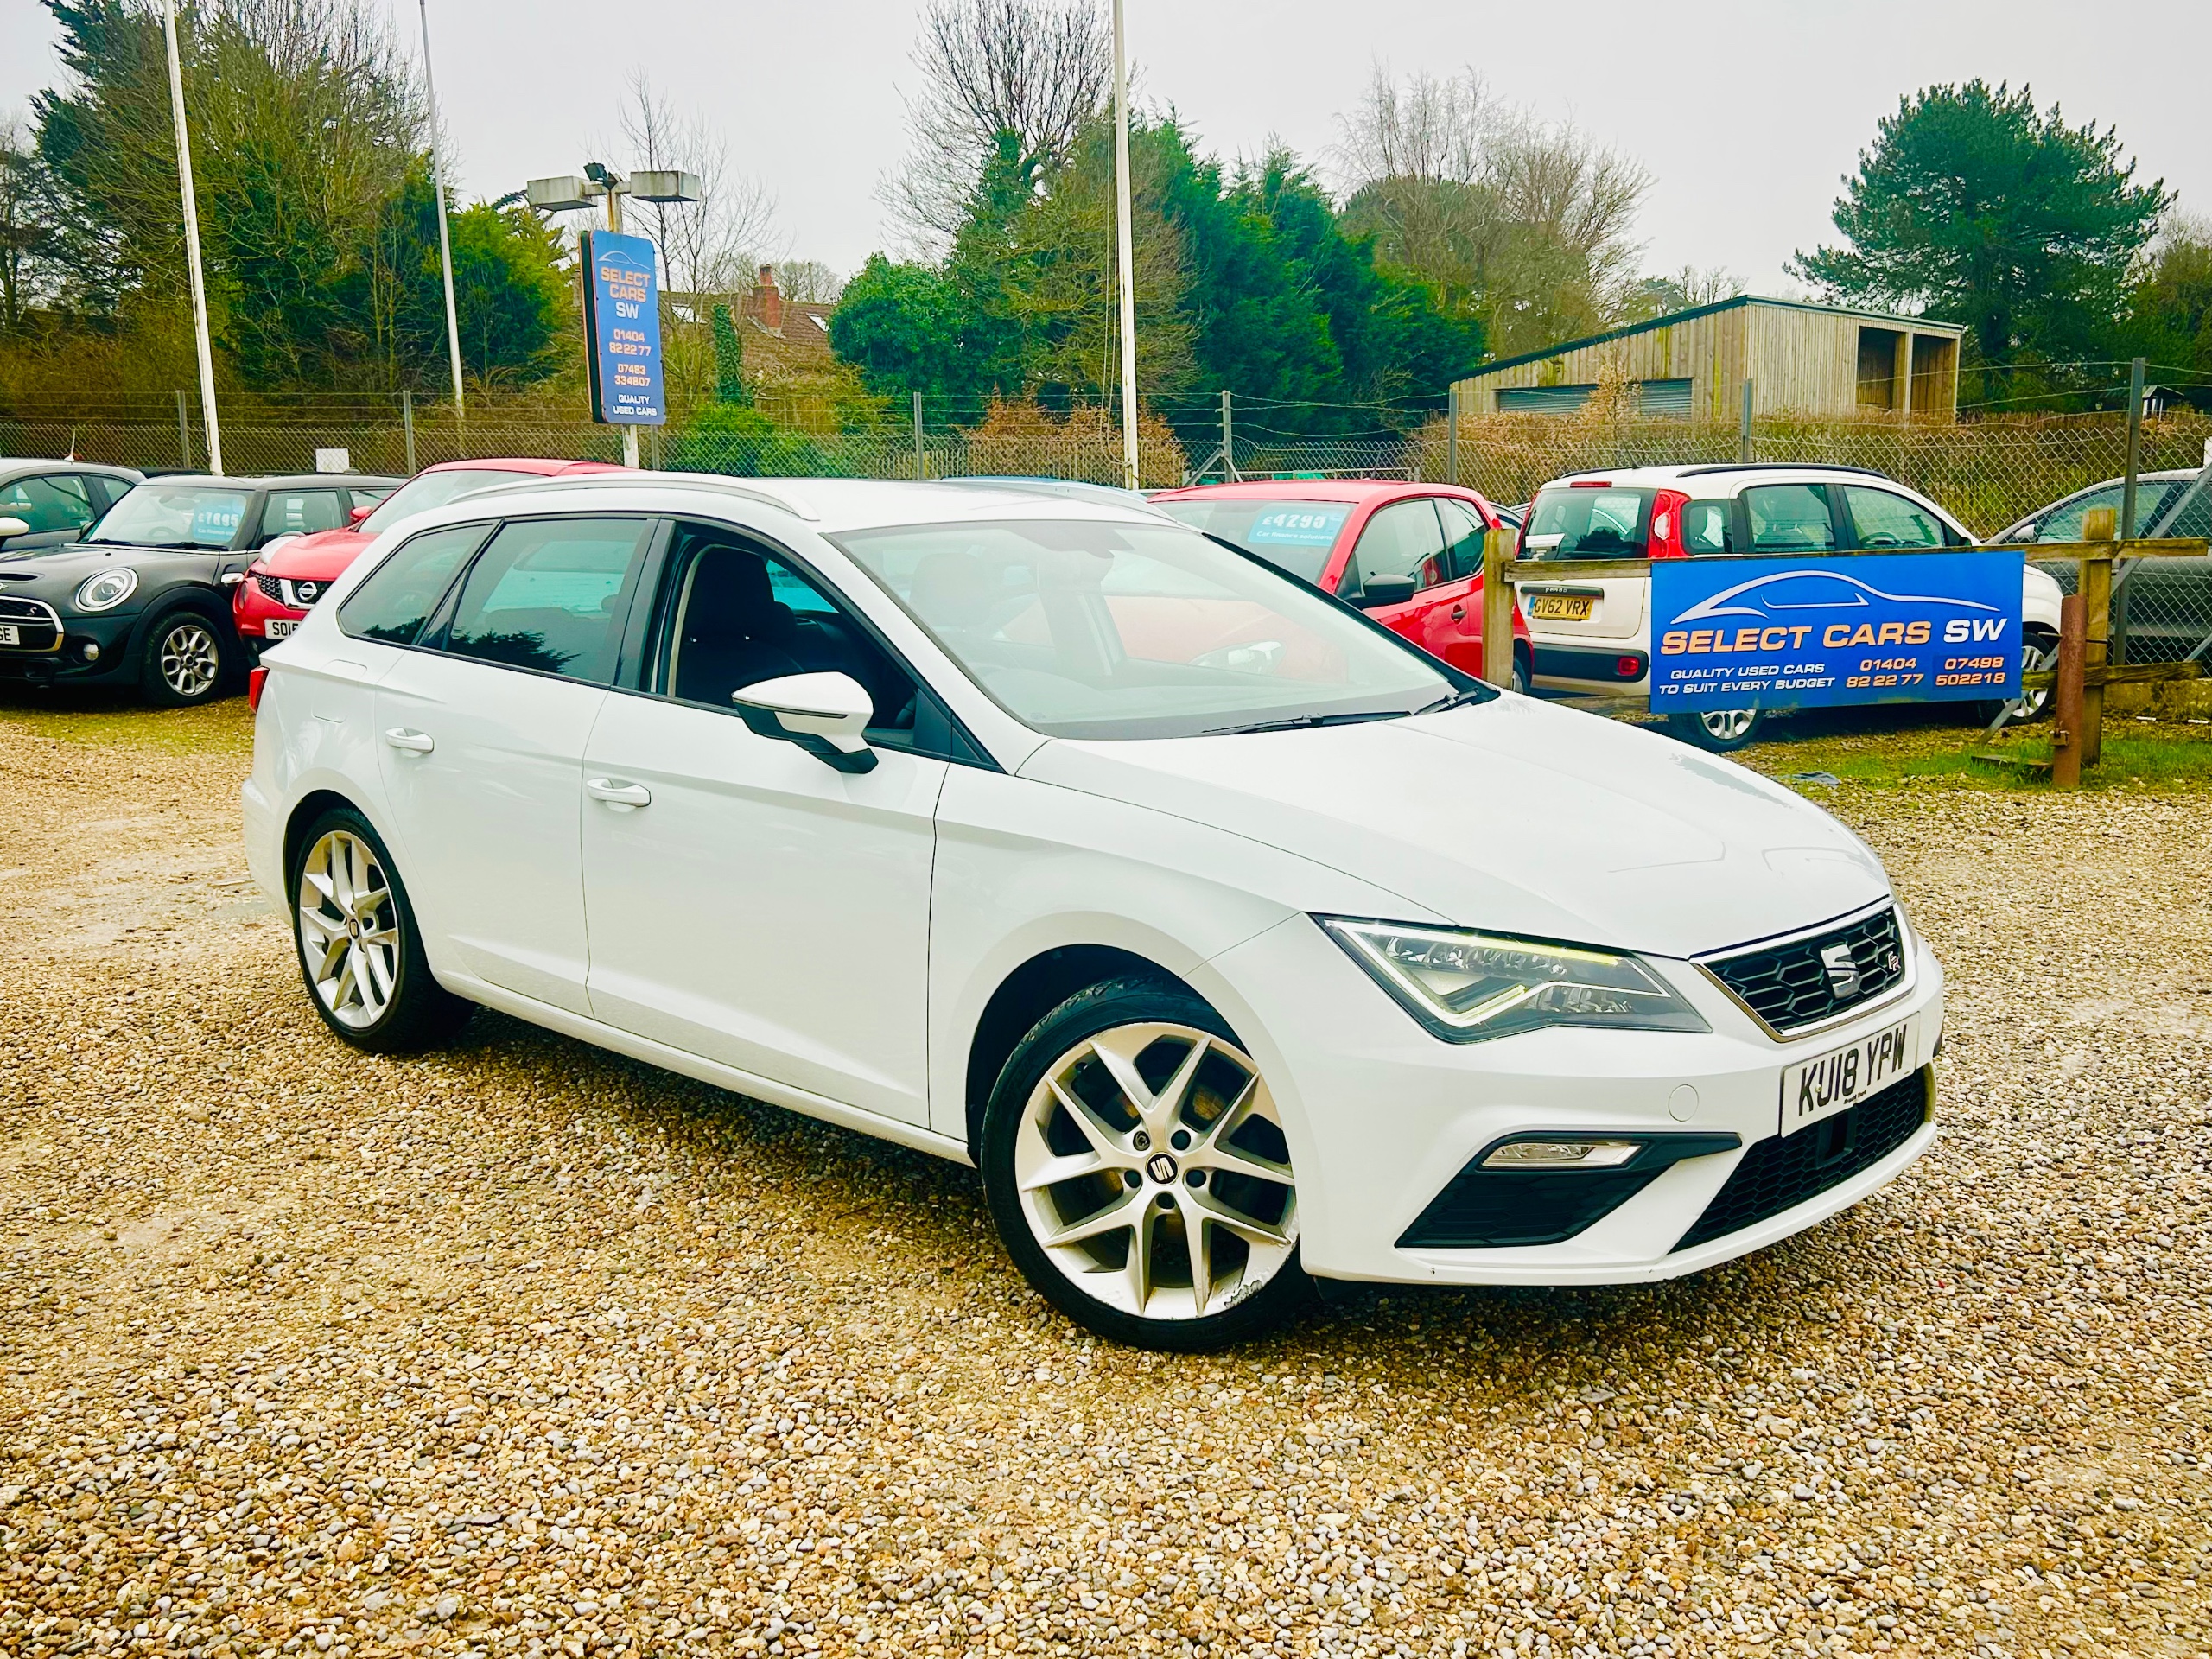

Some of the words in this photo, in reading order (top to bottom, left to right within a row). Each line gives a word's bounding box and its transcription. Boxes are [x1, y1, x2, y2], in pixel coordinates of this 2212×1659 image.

[601, 267, 651, 287] SELECT
[610, 283, 646, 303] CARS
[616, 302, 639, 319] SW
[613, 328, 645, 342] 01404
[618, 394, 650, 404] QUALITY
[613, 405, 634, 415] USED
[636, 406, 657, 416] CARS
[1262, 513, 1327, 529] £4295
[1534, 599, 1563, 613] GV62
[1566, 600, 1589, 616] VRX
[1661, 626, 1813, 655] SELECT
[1823, 620, 1932, 647] CARS
[1944, 618, 2007, 643] SW
[1670, 667, 1735, 680] QUALITY
[1738, 664, 1779, 677] USED
[1783, 663, 1825, 675] CARS
[1859, 658, 1917, 671] 01404
[1944, 656, 2004, 670] 07498
[1659, 684, 1679, 695] TO
[1683, 683, 1718, 694] SUIT
[1720, 680, 1771, 692] EVERY
[1775, 677, 1835, 690] BUDGET
[1936, 672, 2005, 686] 502218
[1799, 1048, 1859, 1116] KU18
[1867, 1024, 1907, 1086] YPW
